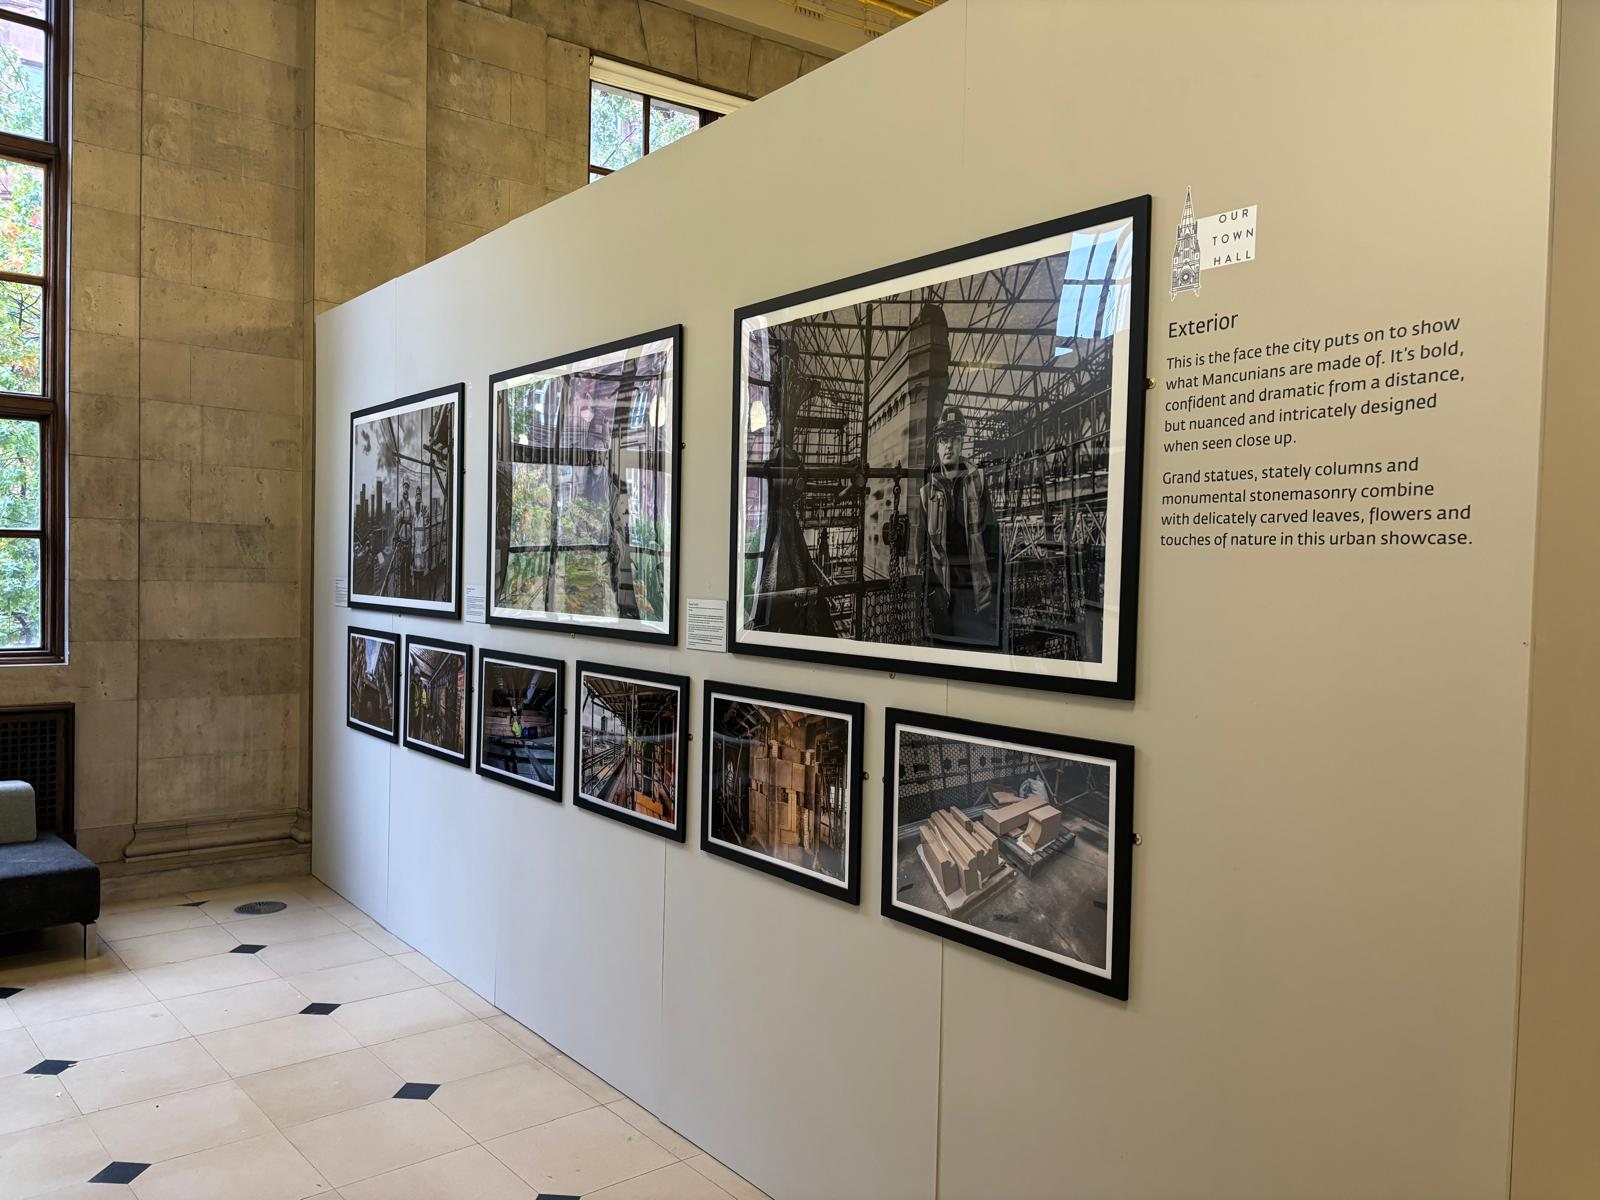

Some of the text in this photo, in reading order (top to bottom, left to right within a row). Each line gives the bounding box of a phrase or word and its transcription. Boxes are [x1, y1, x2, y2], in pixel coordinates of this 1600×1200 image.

[1218, 209, 1249, 223] OUR
[1212, 228, 1254, 246] TOWN
[1213, 251, 1251, 266] HALL
[1168, 312, 1238, 338] Exterior
[1167, 317, 1461, 370] This is the face the city puts on to show
[1166, 340, 1465, 390] what Mancunians are made of. It's bold,
[1165, 368, 1465, 412] confident and dramatic from a distance,
[1165, 393, 1438, 432] but nuanced and intricately designed
[1164, 432, 1296, 452] when seen close up.
[1162, 457, 1419, 485] Grand statues, stately columns and
[1162, 482, 1435, 505] monumental stonemasonry combine
[1161, 505, 1471, 527] with delicately carved leaves, flowers and
[1161, 531, 1473, 549] touches of nature in this urban showcase.
